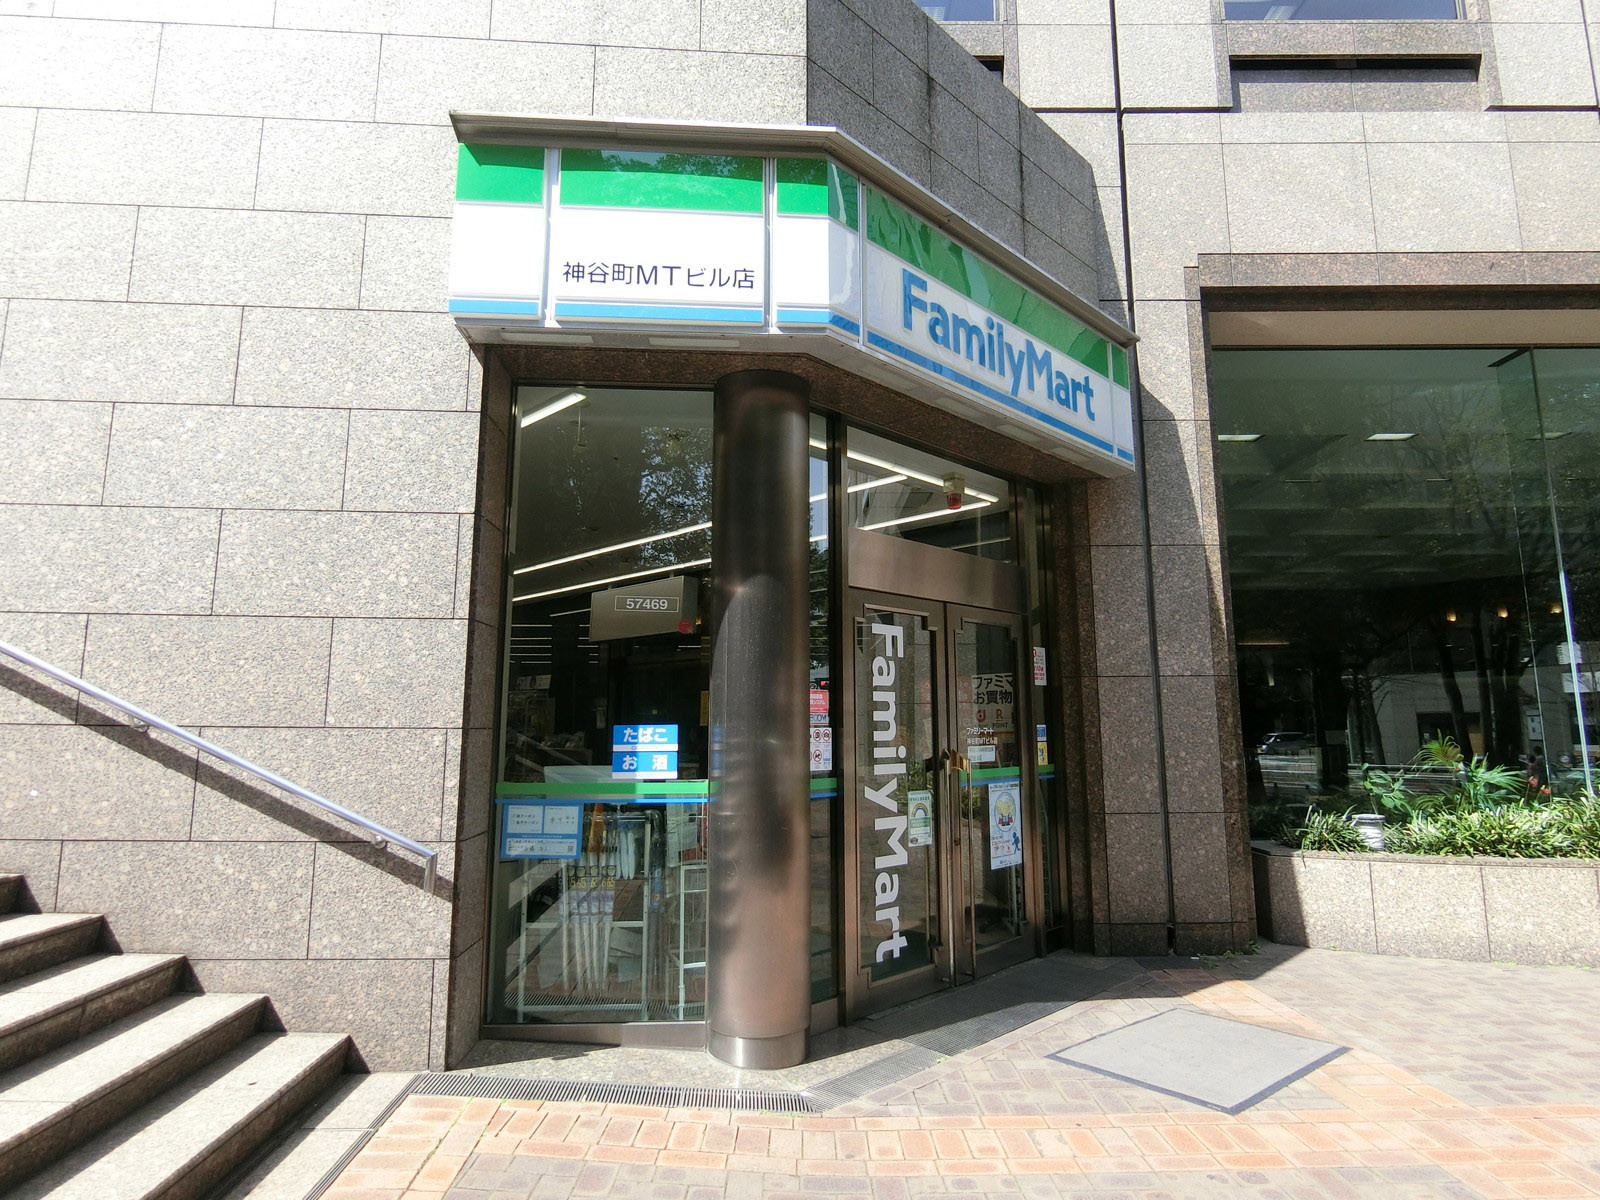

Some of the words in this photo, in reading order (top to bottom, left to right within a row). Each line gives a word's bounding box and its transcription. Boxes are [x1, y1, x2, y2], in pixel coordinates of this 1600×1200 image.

[563, 261, 755, 290] 神谷町MTビル店
[902, 267, 1096, 423] FamilyMart
[625, 598, 669, 610] 57469
[623, 727, 668, 743] たばこ
[864, 622, 909, 964] FamilyMart
